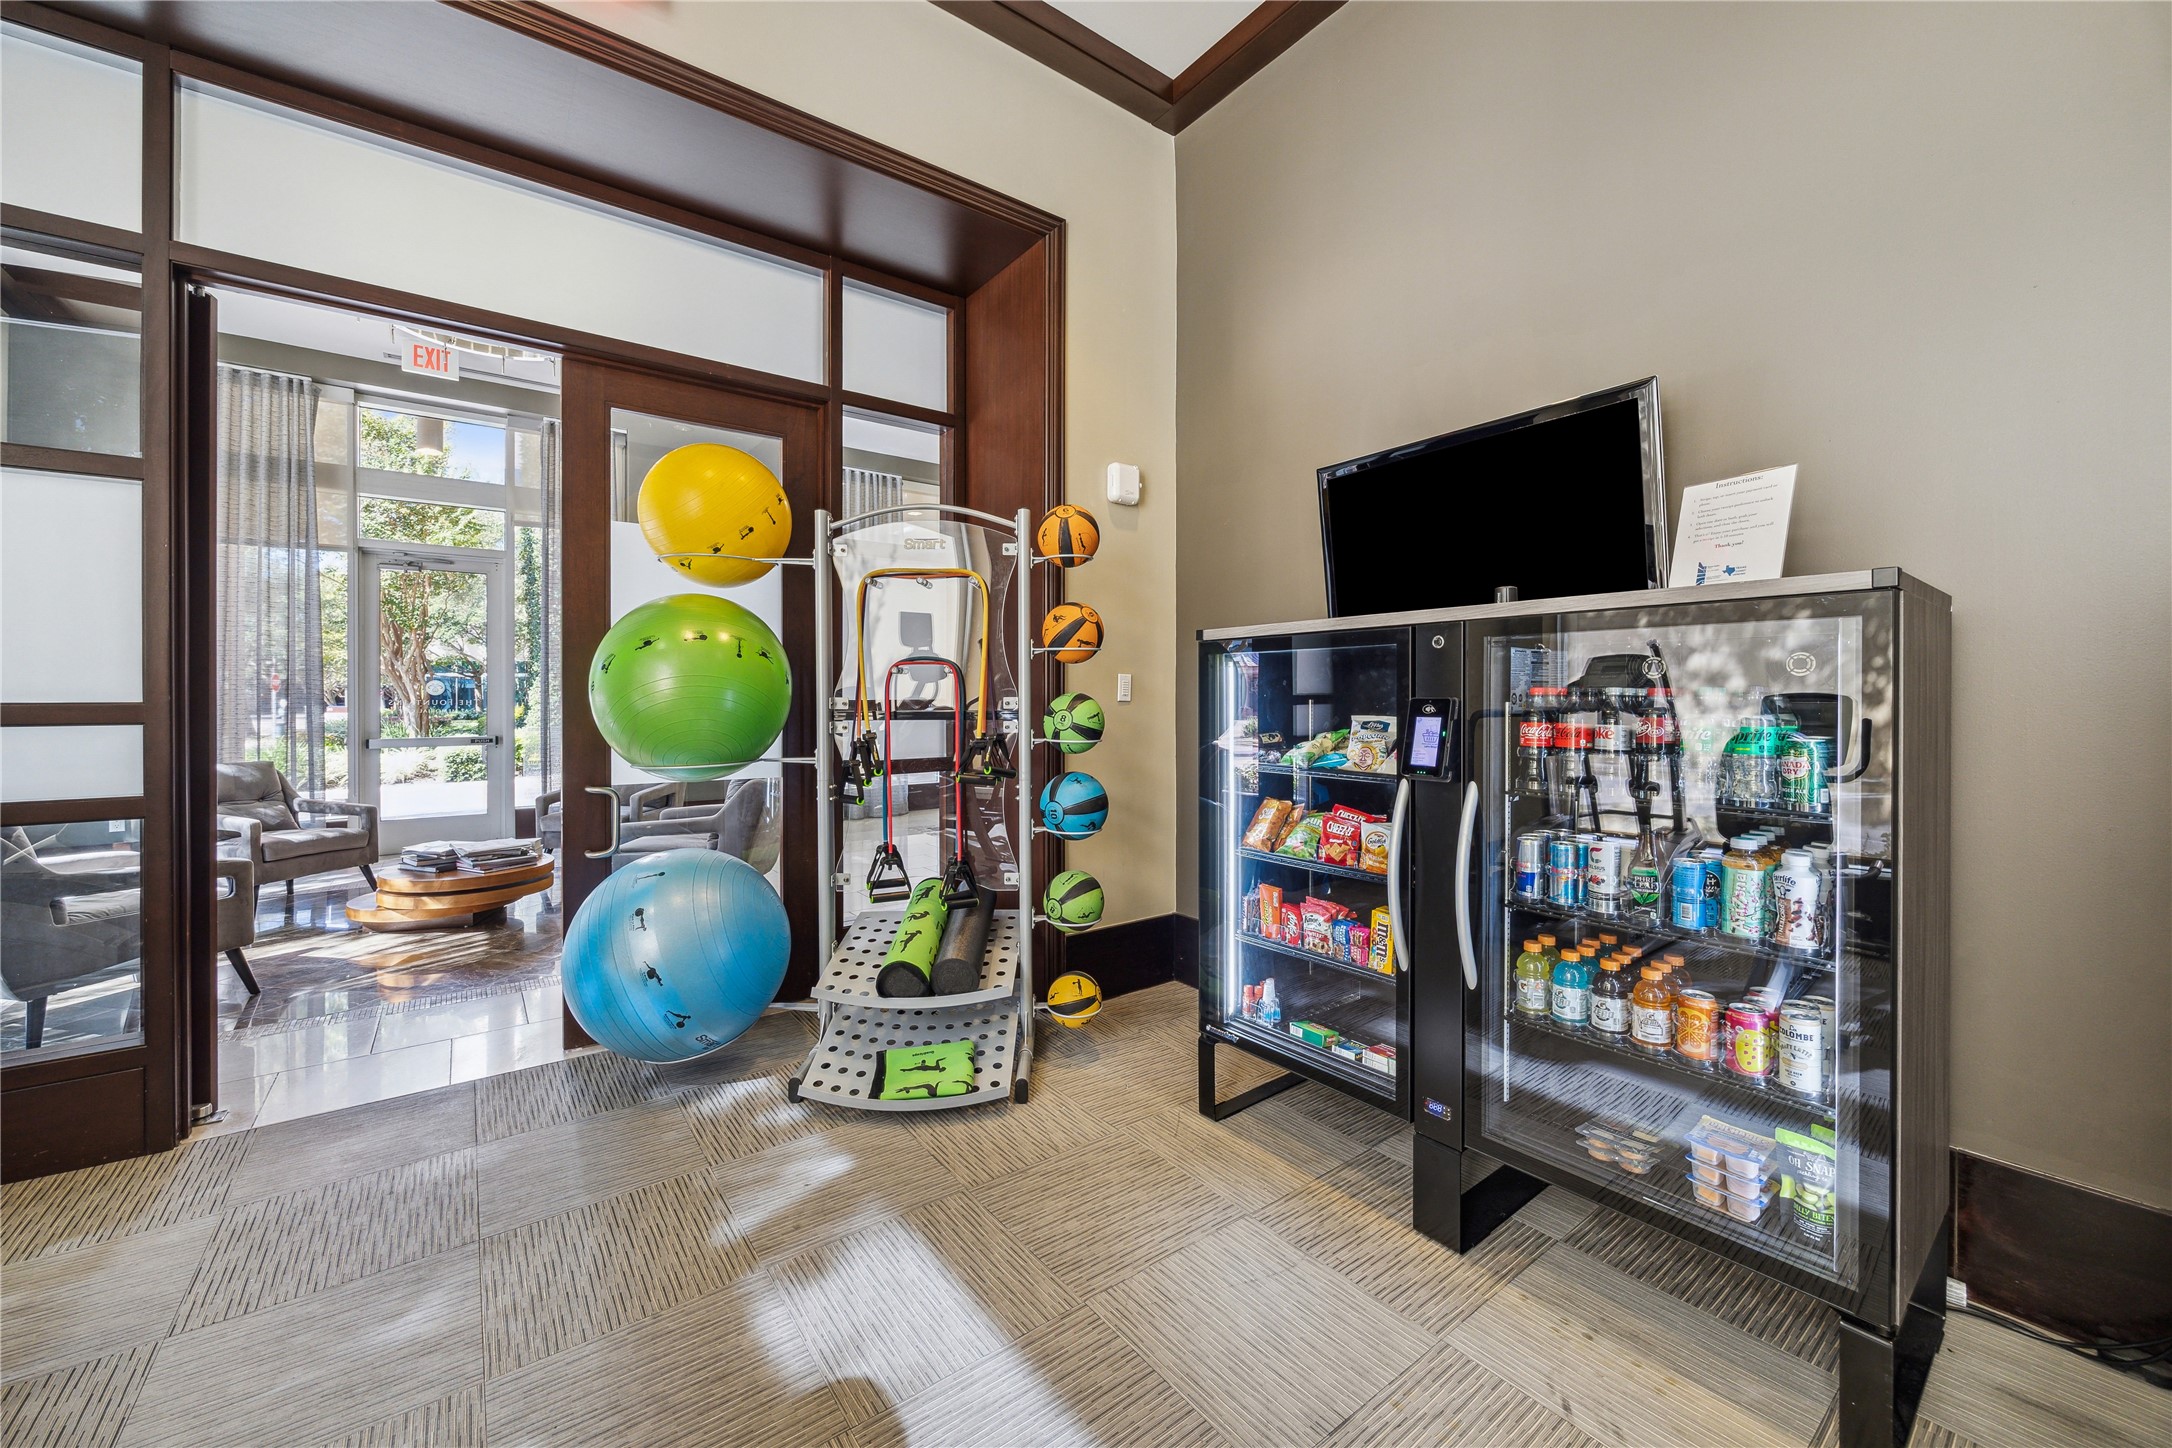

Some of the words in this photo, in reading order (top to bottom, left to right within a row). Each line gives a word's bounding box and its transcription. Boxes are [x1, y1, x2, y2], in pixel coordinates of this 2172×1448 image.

[413, 344, 451, 373] EXIT
[1715, 475, 1764, 489] Instructions:
[903, 538, 947, 550] Smart
[1060, 714, 1067, 722] 8
[1050, 809, 1058, 819] 10
[1326, 821, 1355, 837] CHEEZ-IT
[1367, 837, 1387, 845] Goldfish
[1634, 876, 1656, 884] PURE
[1553, 995, 1571, 1007] ZERO
[1594, 1007, 1615, 1018] ZERO
[1779, 1026, 1814, 1042] COLOMBE
[1789, 1024, 1798, 1032] La
[1725, 1021, 1735, 1050] poppi
[1793, 1044, 1813, 1058] LATTE
[1788, 1155, 1801, 1168] OH
[1805, 1161, 1836, 1178] SNAP
